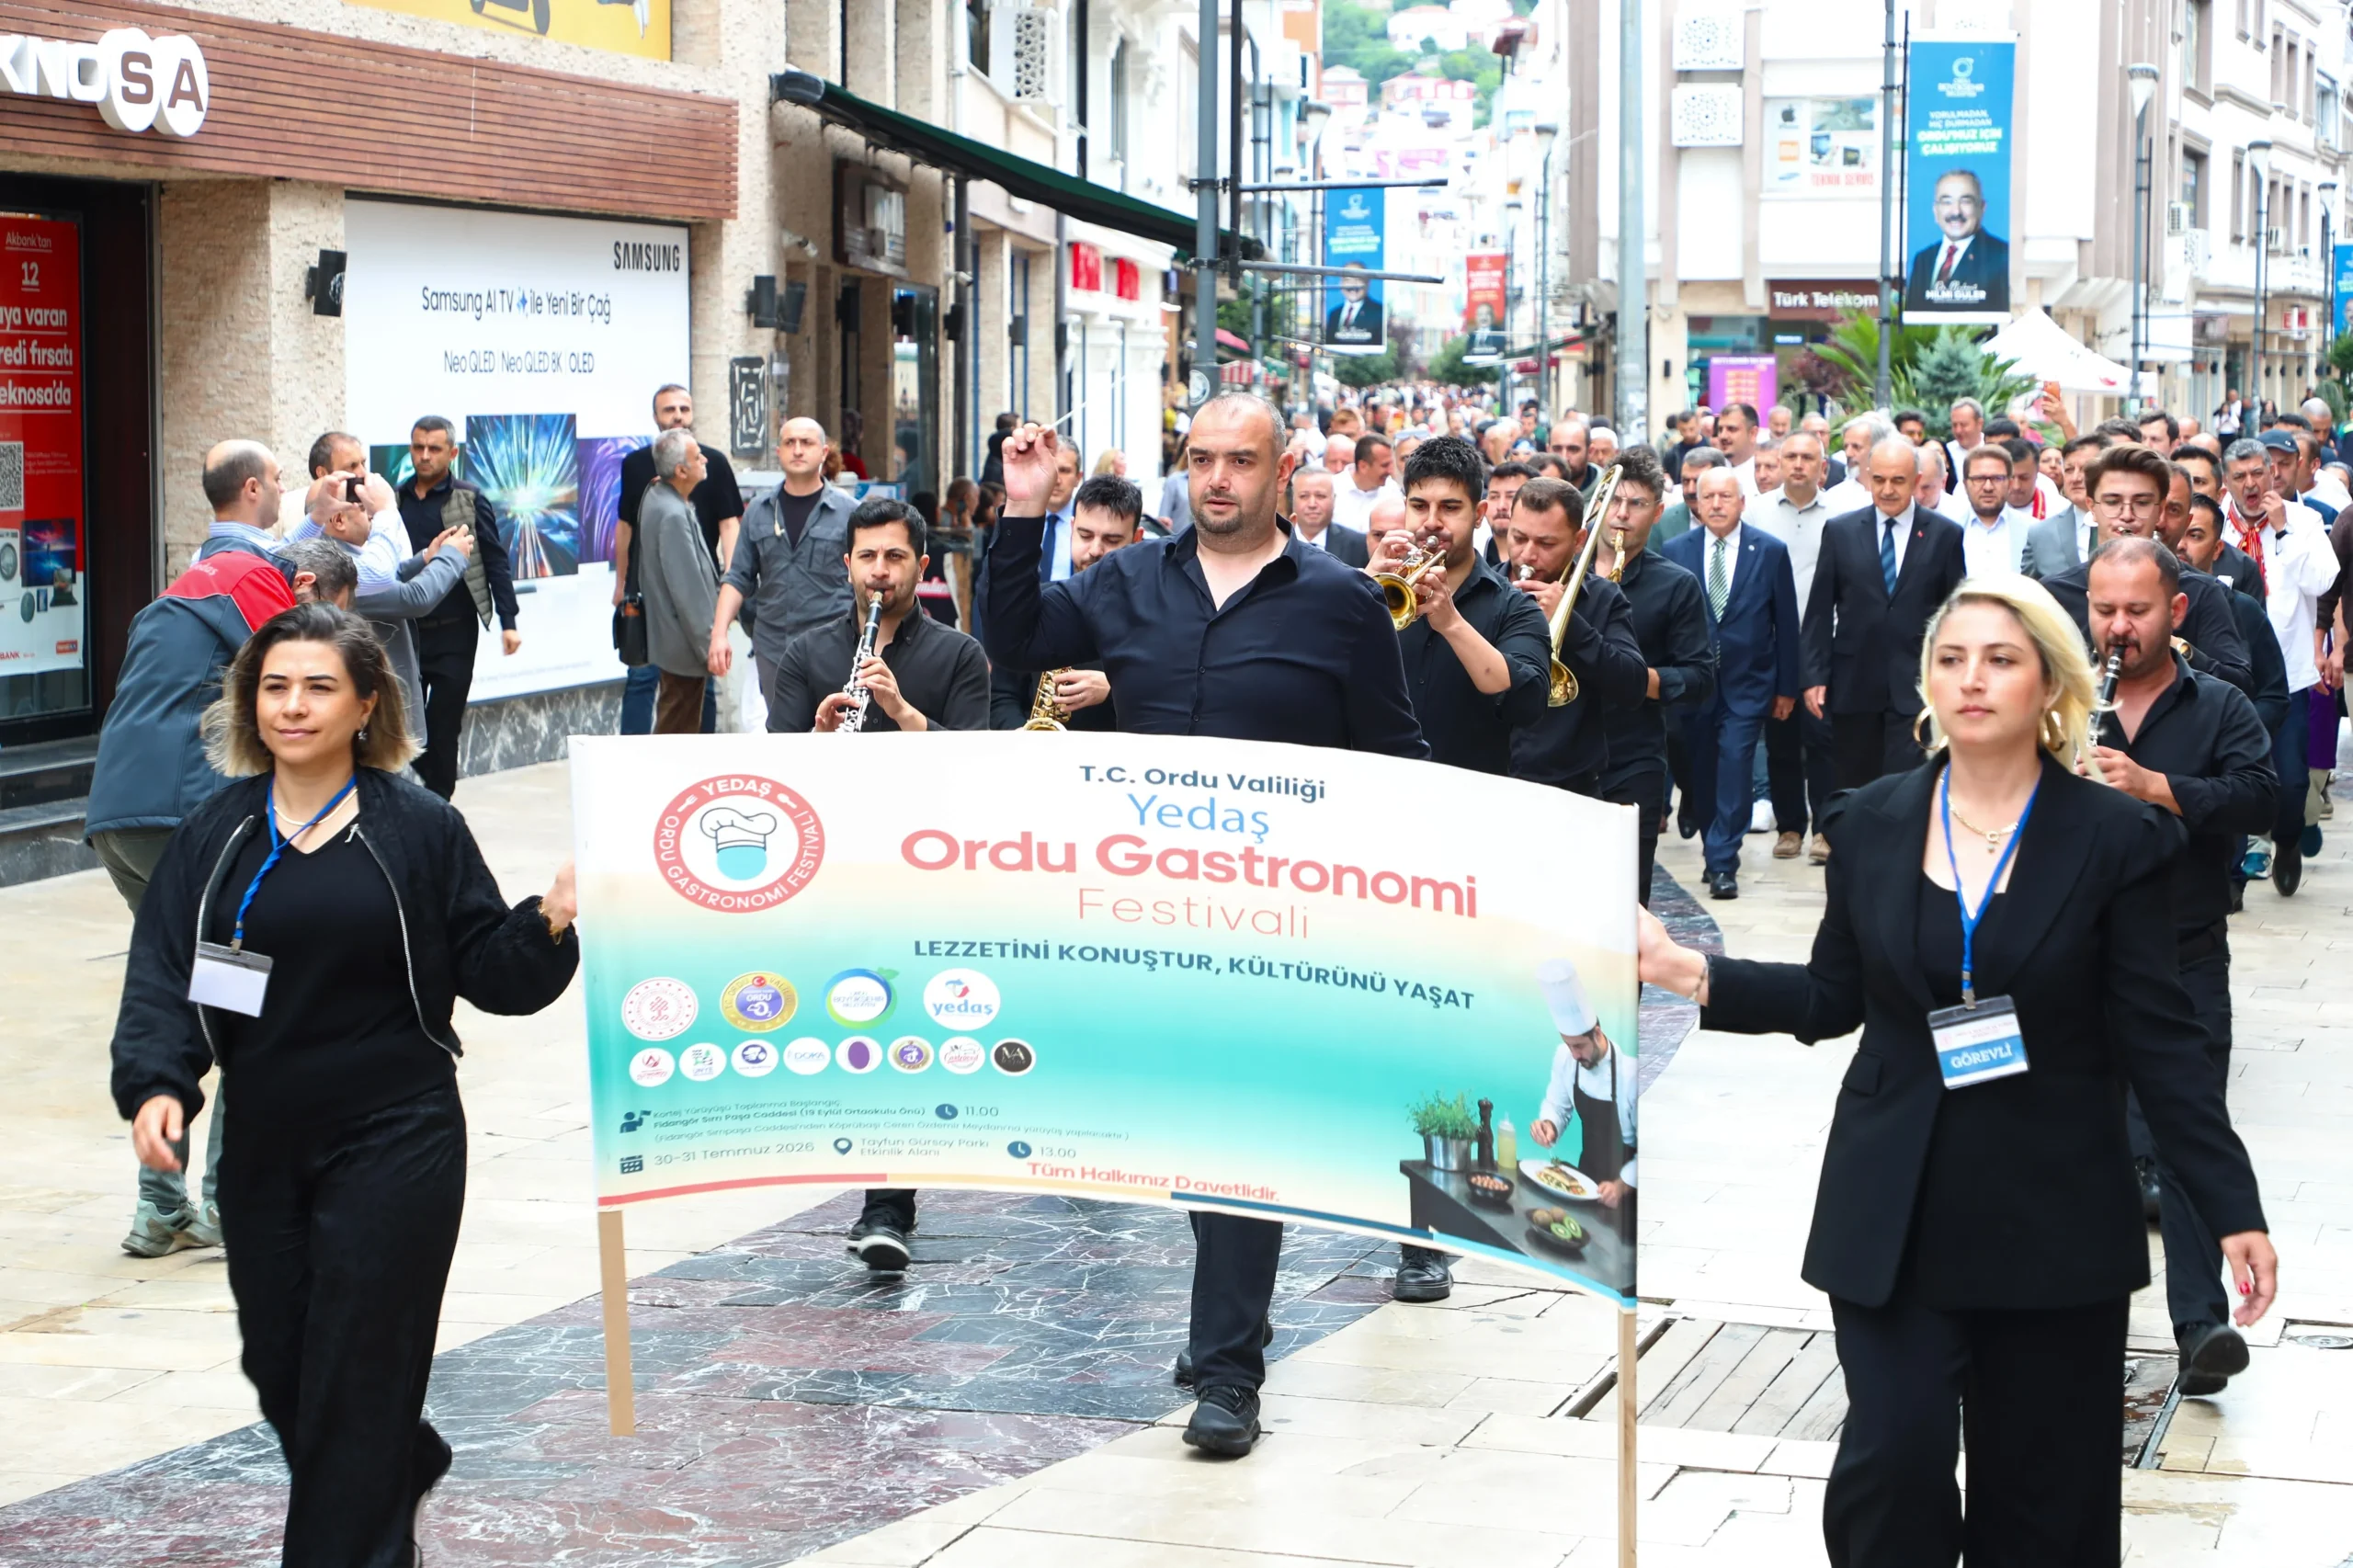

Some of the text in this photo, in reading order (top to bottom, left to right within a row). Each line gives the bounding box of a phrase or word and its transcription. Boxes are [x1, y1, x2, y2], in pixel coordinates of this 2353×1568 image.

[6, 232, 52, 248] Akbank'tan
[613, 241, 680, 272] SAMSUNG
[21, 261, 40, 286] 12
[422, 286, 482, 321] Samsung
[499, 290, 514, 312] TV
[530, 289, 543, 314] ile
[546, 290, 569, 315] Yeni
[571, 292, 585, 316] Bir
[587, 292, 611, 324] Çağ
[1773, 290, 1879, 309] Türk Telekom
[25, 306, 67, 327] varan
[29, 340, 73, 366] fırsatı
[444, 350, 595, 374] Neo QLED Neo QLED 8K OLED
[701, 778, 772, 798] YEDAŞ
[1079, 766, 1324, 803] T.C. Ordu Valiliği
[1127, 793, 1269, 844] Yedaş
[659, 815, 680, 861] ORDU
[901, 829, 1477, 919] Ordu Gastronomi
[667, 866, 789, 909] GASTRONOMİ
[1079, 888, 1307, 938] Festivali
[914, 938, 1474, 1010] LEZZETİNİ KONUŞTUR, KÜLTÜRÜNÜ YAŞAT
[745, 993, 772, 1002] ORDU
[932, 999, 994, 1016] yedaş
[1950, 1041, 2013, 1069] GÖREVLİ
[654, 1117, 699, 1129] Fidangör
[724, 1113, 750, 1123] Paşa
[753, 1110, 797, 1119] Caddesi
[800, 1108, 815, 1117] (19
[817, 1108, 842, 1117] Eylül
[899, 1107, 926, 1116] Önü)
[965, 1106, 999, 1117] 11.00
[654, 1142, 814, 1166] 30-31 Temmuz 2026
[860, 1147, 940, 1156] Etkinlik Alanı
[861, 1137, 989, 1149] Tayfun Gürsoy Parkı
[1040, 1146, 1076, 1158] 13.00
[1027, 1162, 1074, 1178] Tüm
[1080, 1166, 1169, 1187] Halkımız
